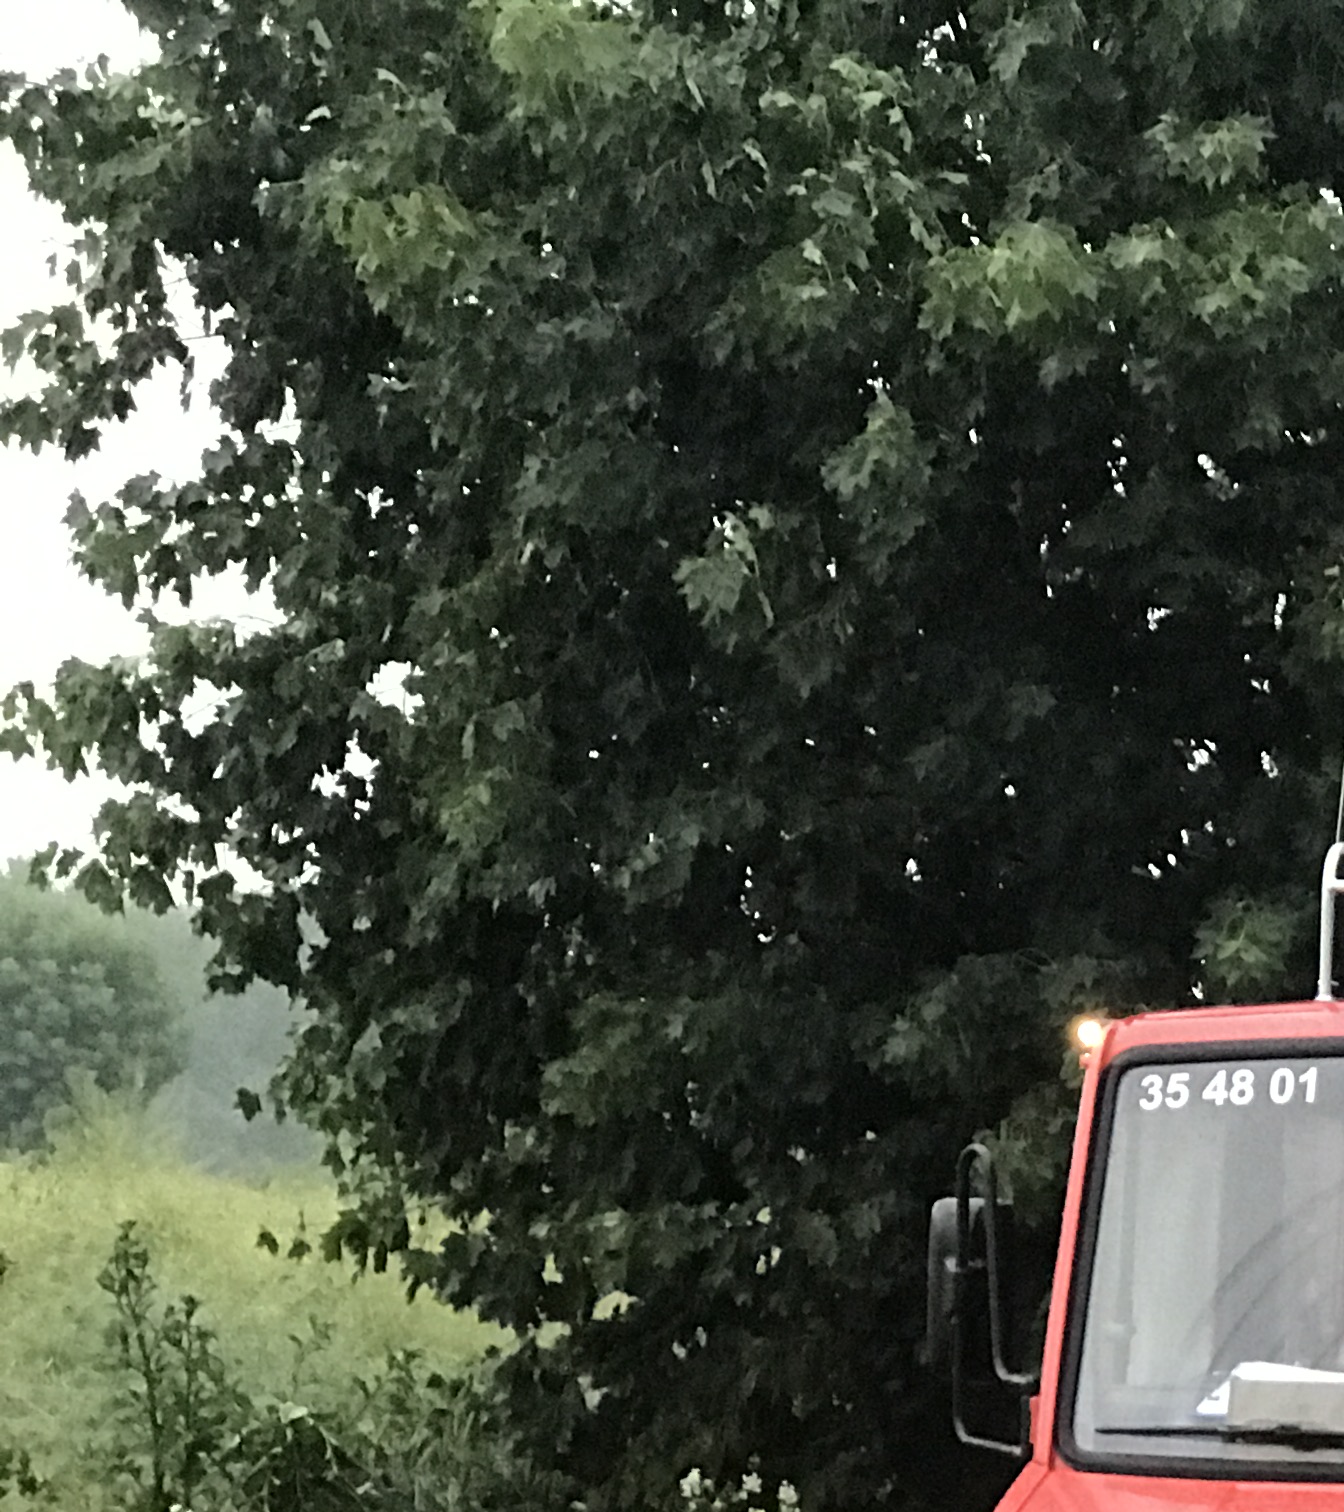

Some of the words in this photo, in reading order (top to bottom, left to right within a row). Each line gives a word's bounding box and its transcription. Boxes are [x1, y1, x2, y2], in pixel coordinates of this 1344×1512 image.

[1139, 1072, 1190, 1110] 35
[1202, 1069, 1255, 1106] 48
[1269, 1067, 1317, 1104] 01
